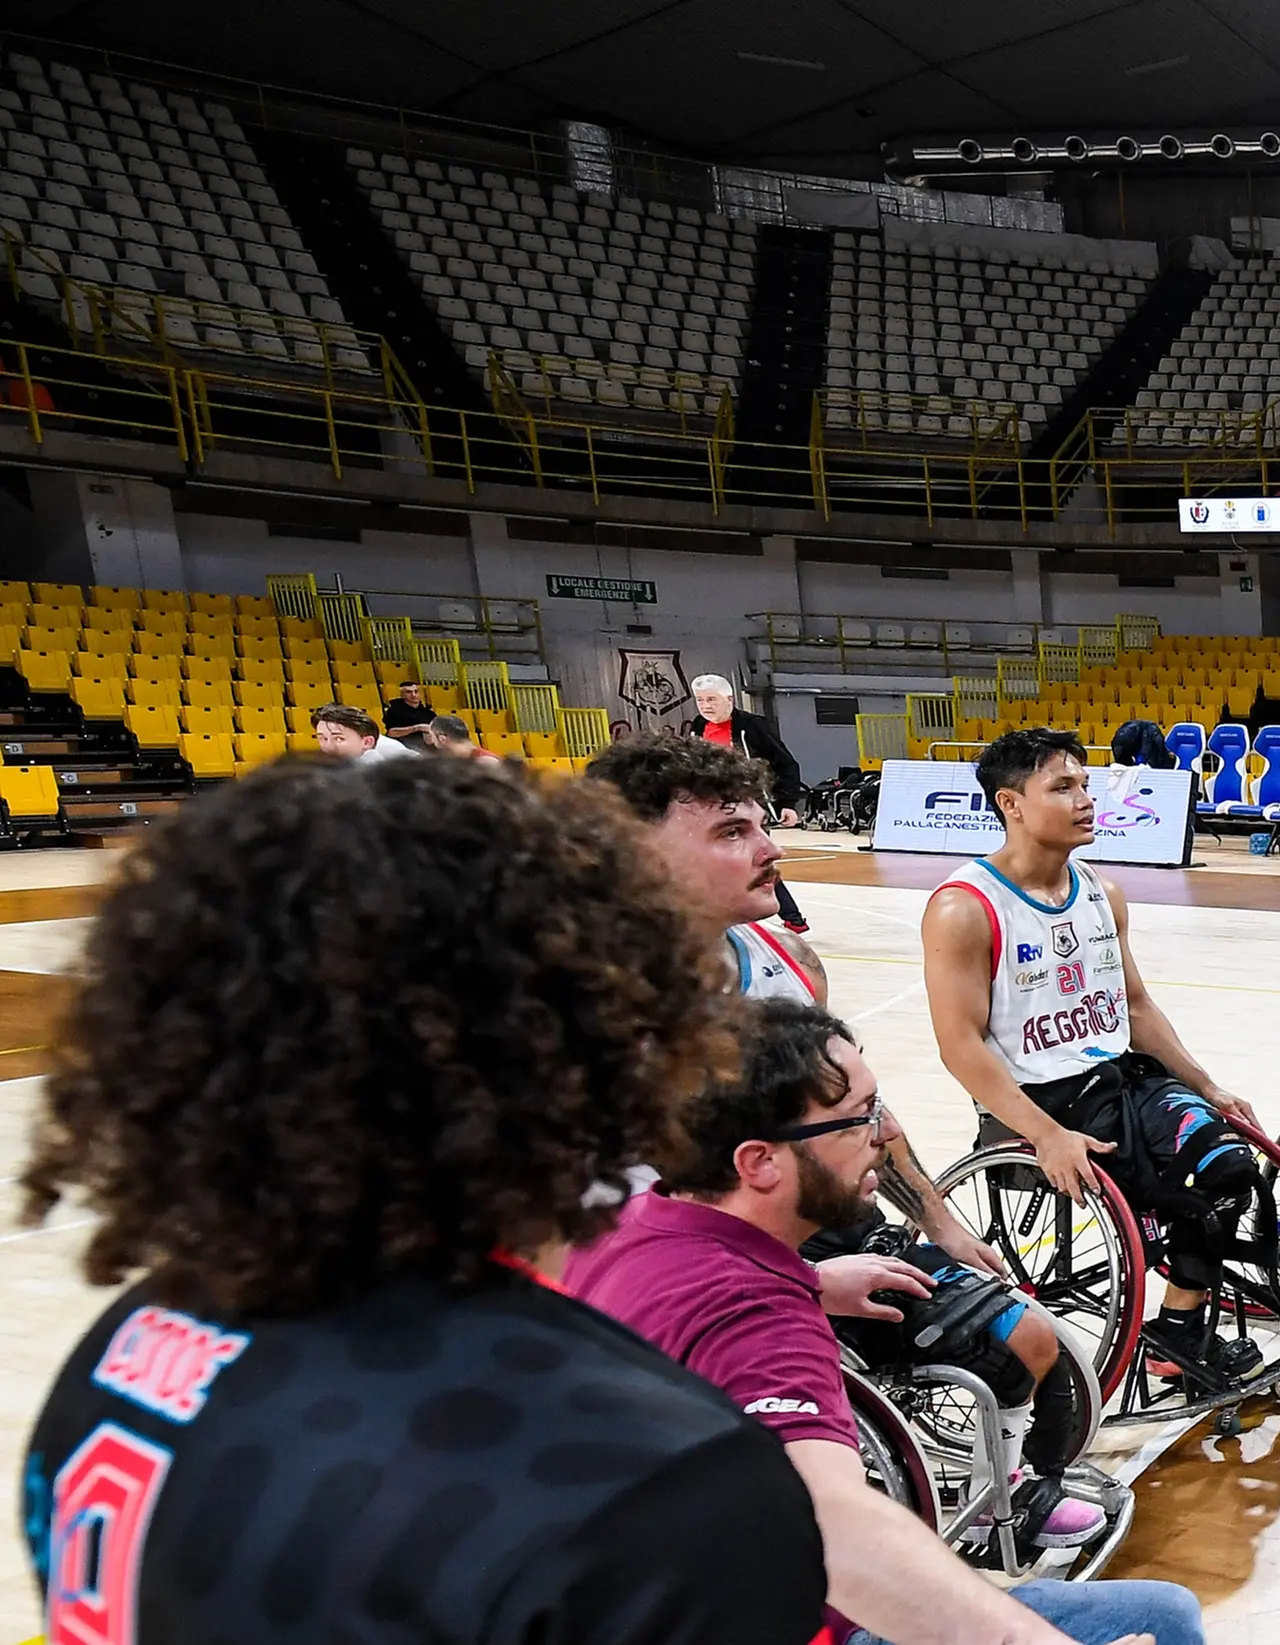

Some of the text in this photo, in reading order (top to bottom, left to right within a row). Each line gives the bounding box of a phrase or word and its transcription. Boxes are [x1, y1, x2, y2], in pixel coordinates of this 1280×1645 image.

[559, 577, 595, 589] LOCALE
[574, 588, 630, 600] EMERGENZE
[926, 813, 1000, 823] FEDERAZIO
[1057, 960, 1087, 997] 21
